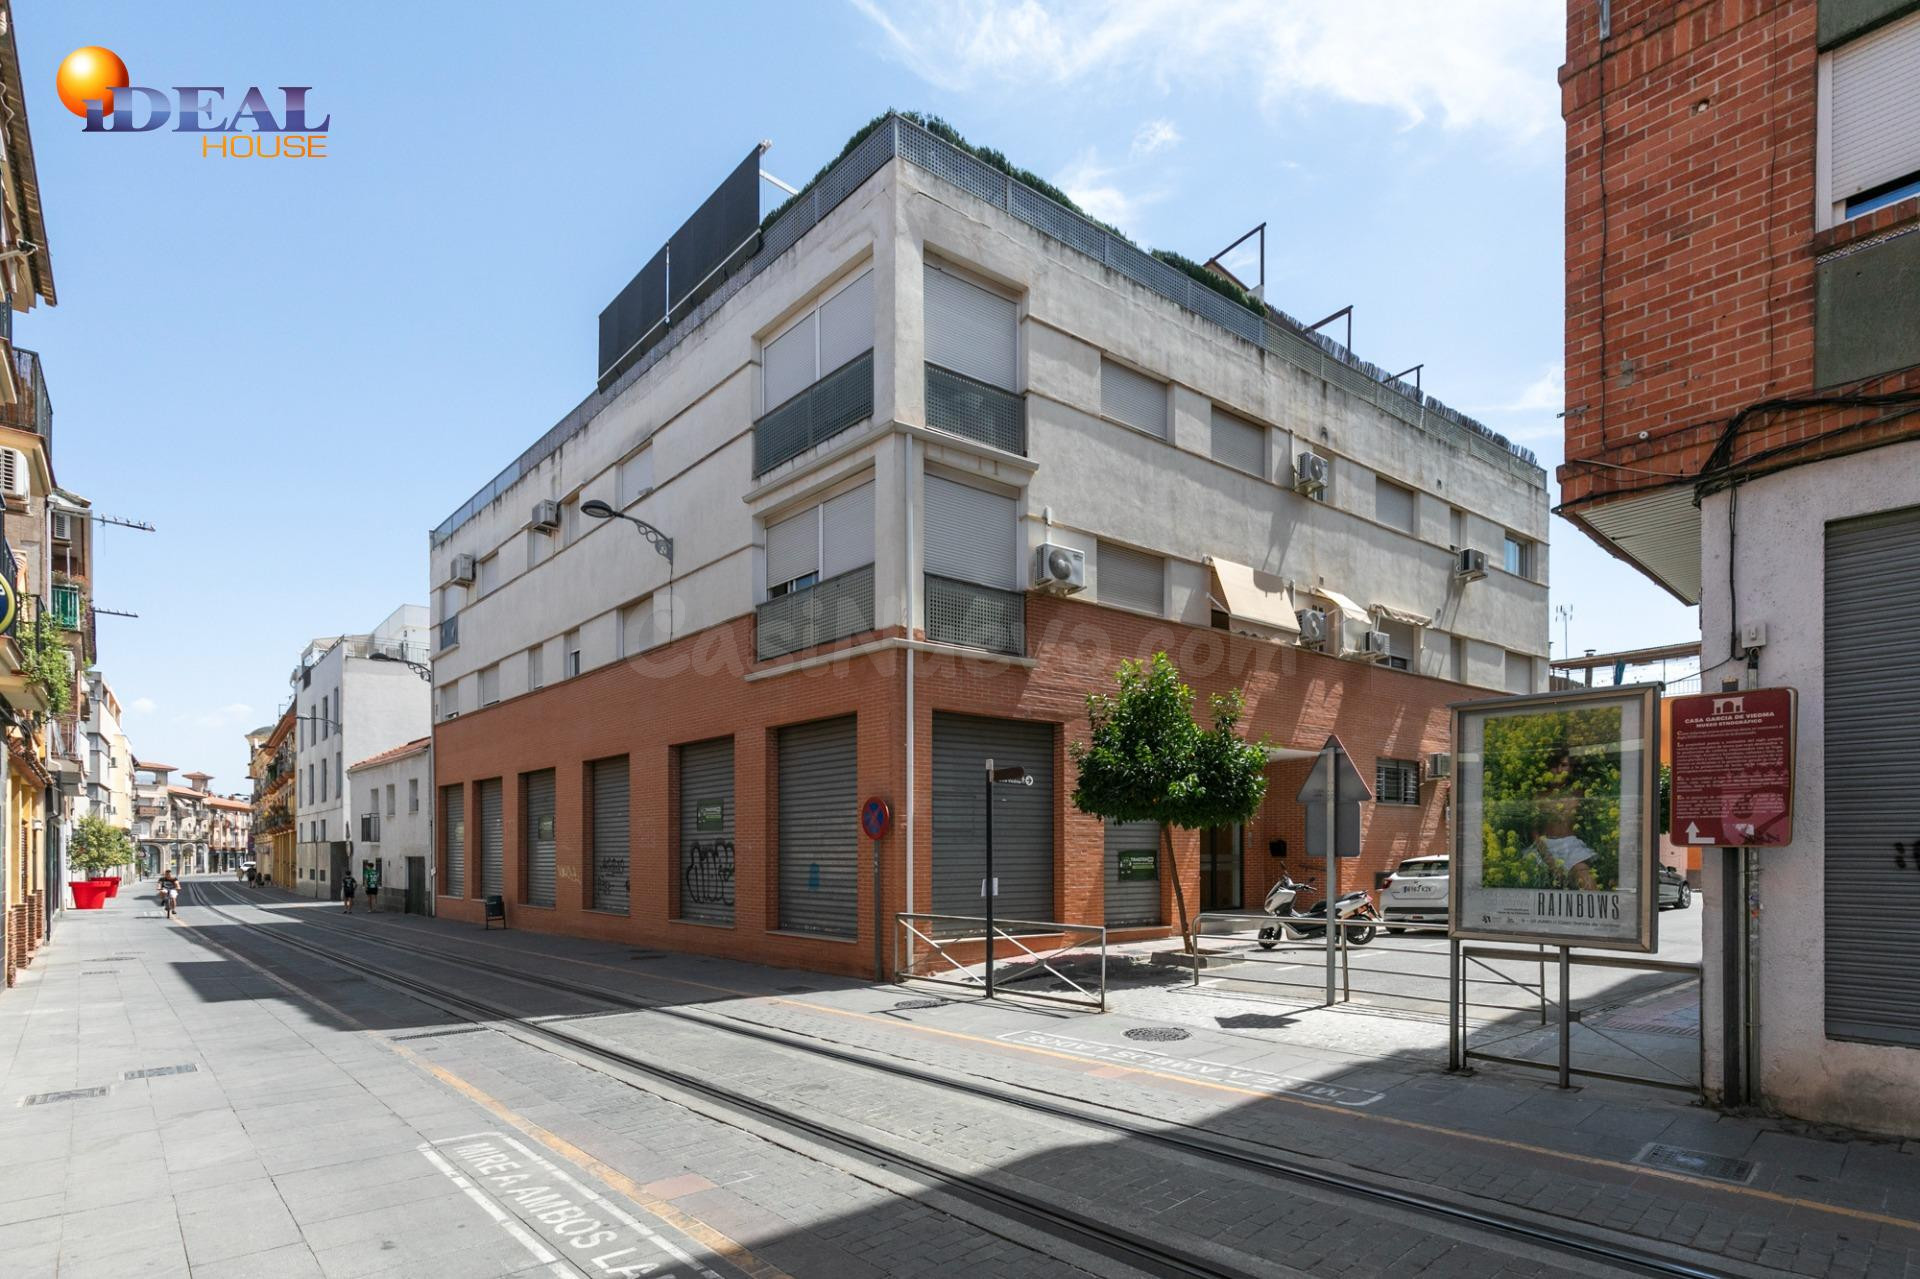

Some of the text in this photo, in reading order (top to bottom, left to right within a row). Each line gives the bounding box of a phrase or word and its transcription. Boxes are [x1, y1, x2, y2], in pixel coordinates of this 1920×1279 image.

[1537, 892, 1620, 920] RAINBOWS
[456, 1142, 522, 1176] MIRE
[489, 1173, 531, 1188] A
[506, 1186, 619, 1249] AMBOS
